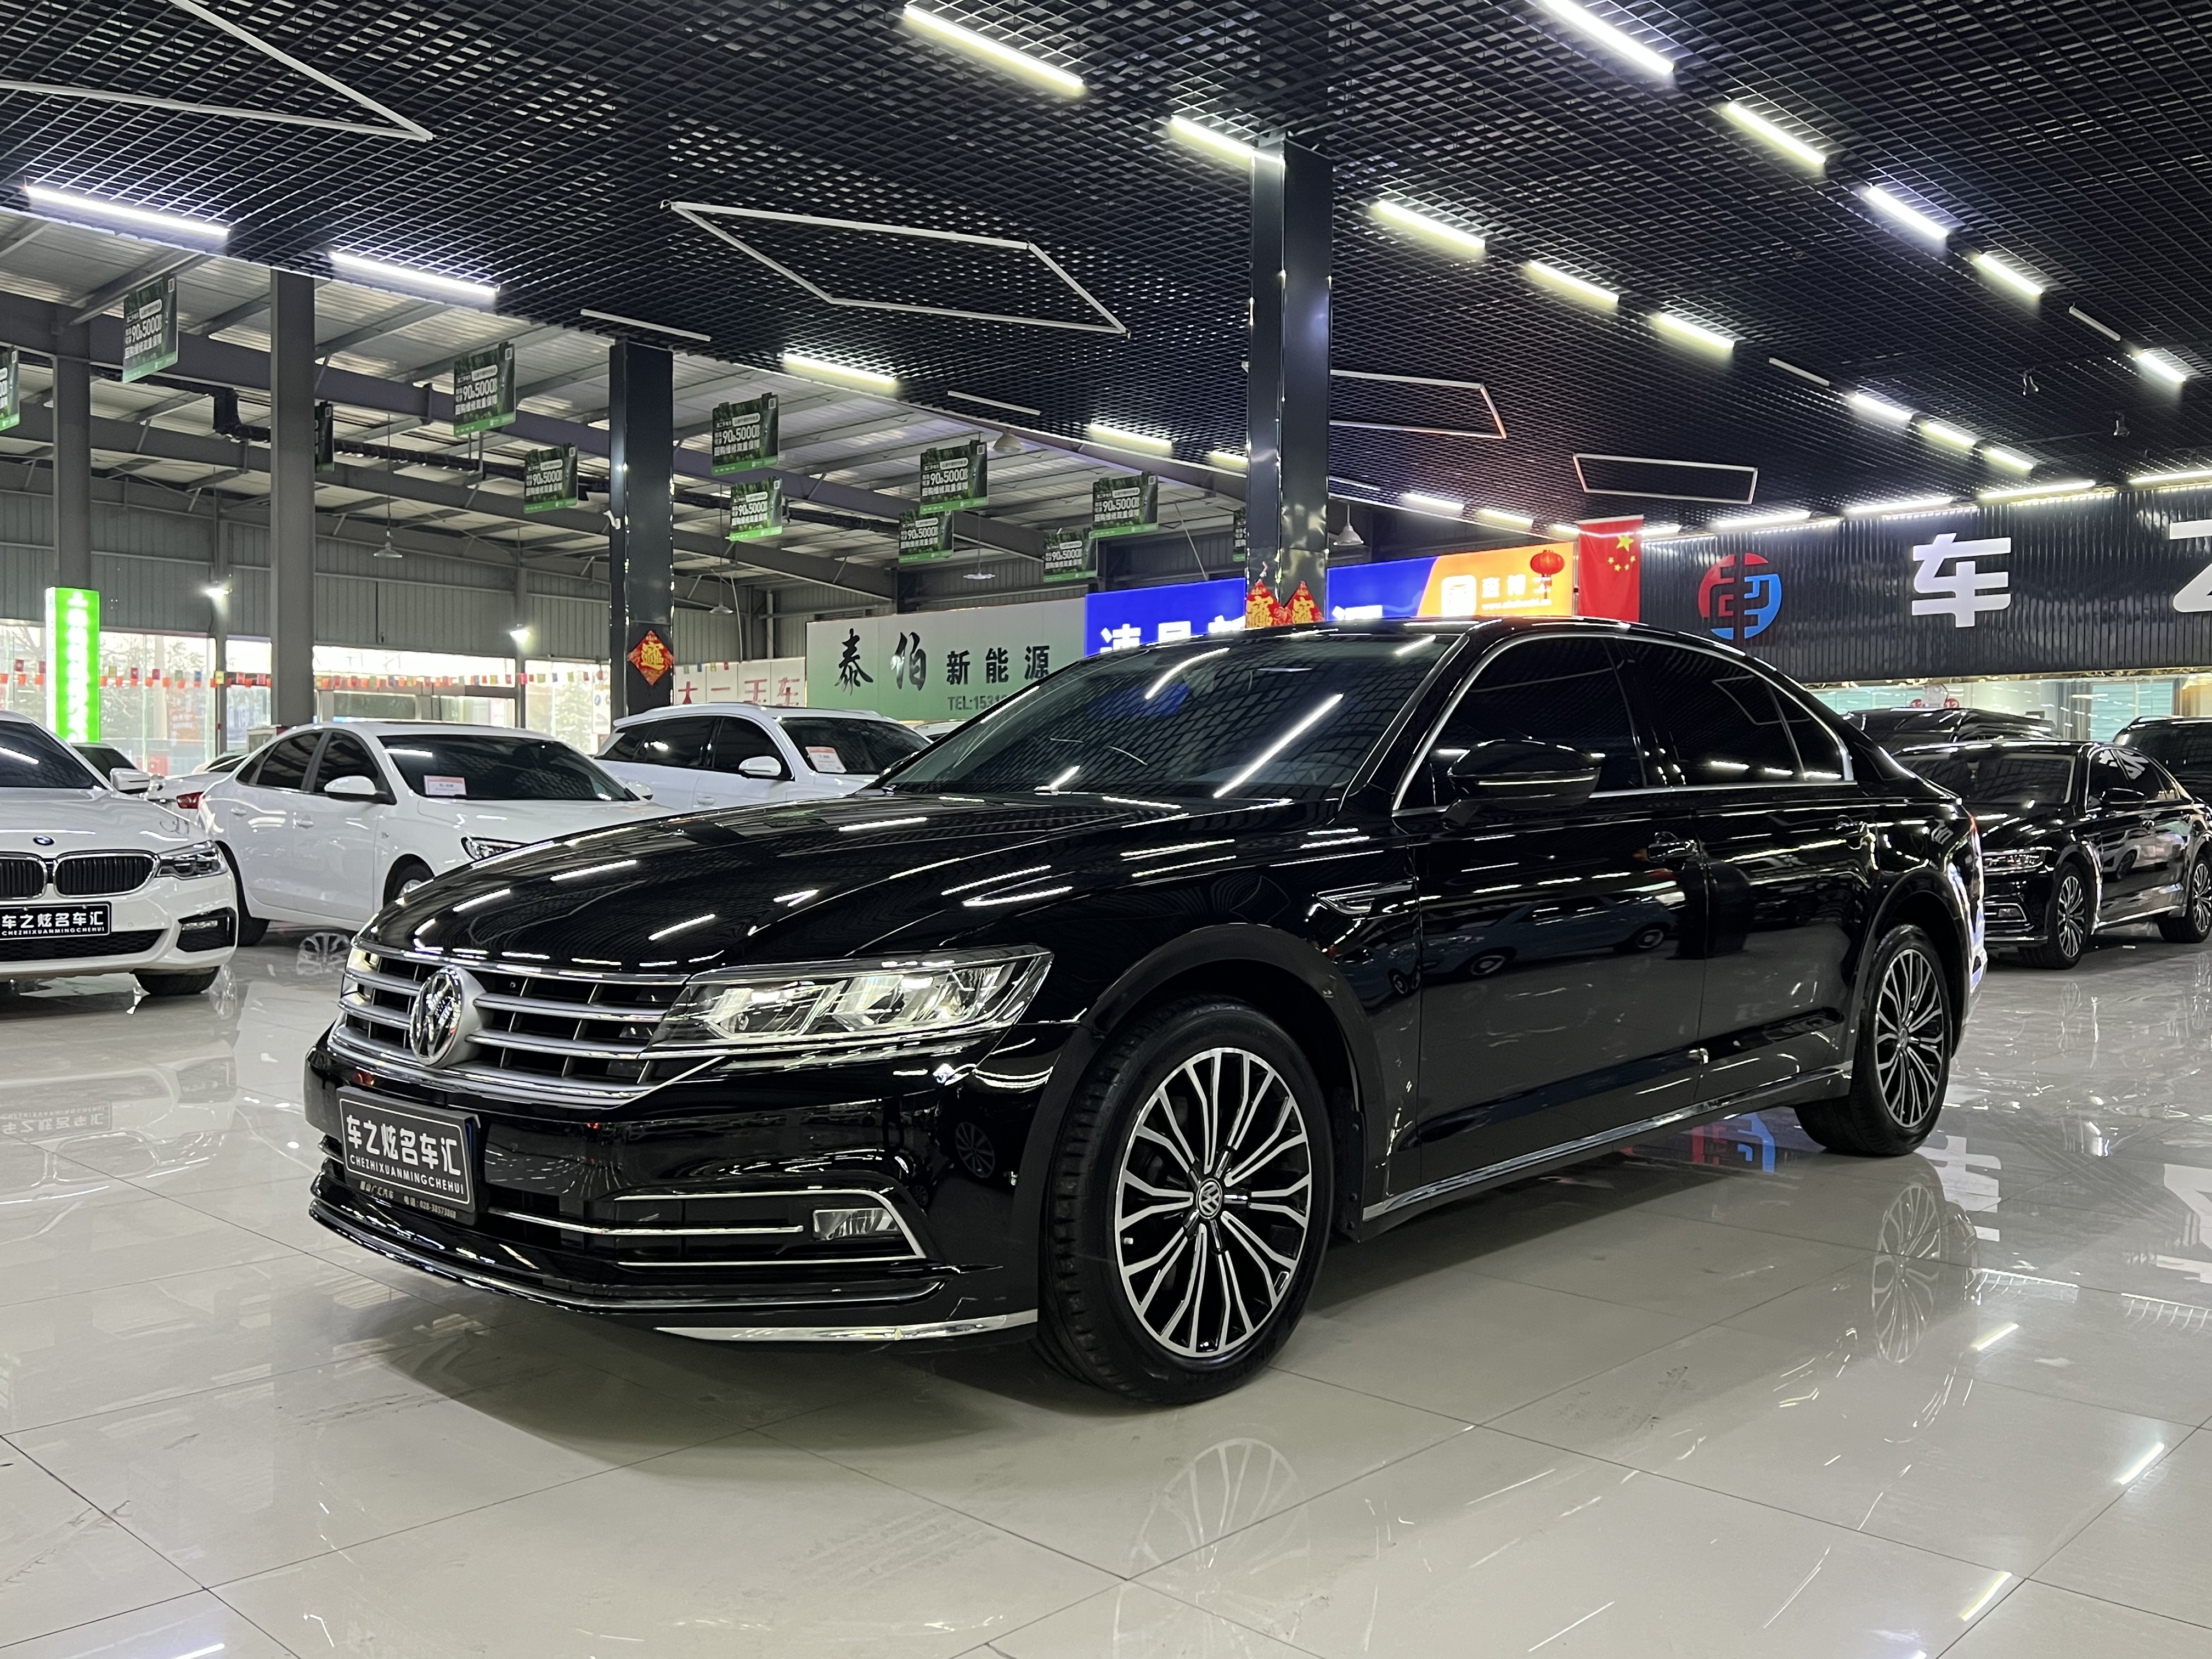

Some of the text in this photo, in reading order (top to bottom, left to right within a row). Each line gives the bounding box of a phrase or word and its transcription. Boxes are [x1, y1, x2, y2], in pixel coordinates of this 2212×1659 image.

[2, 911, 104, 929] 车之炫名车汇
[347, 1114, 461, 1176] 车之炫名车汇
[349, 1154, 464, 1195] CHEZHIXUANMINGCHEHUI
